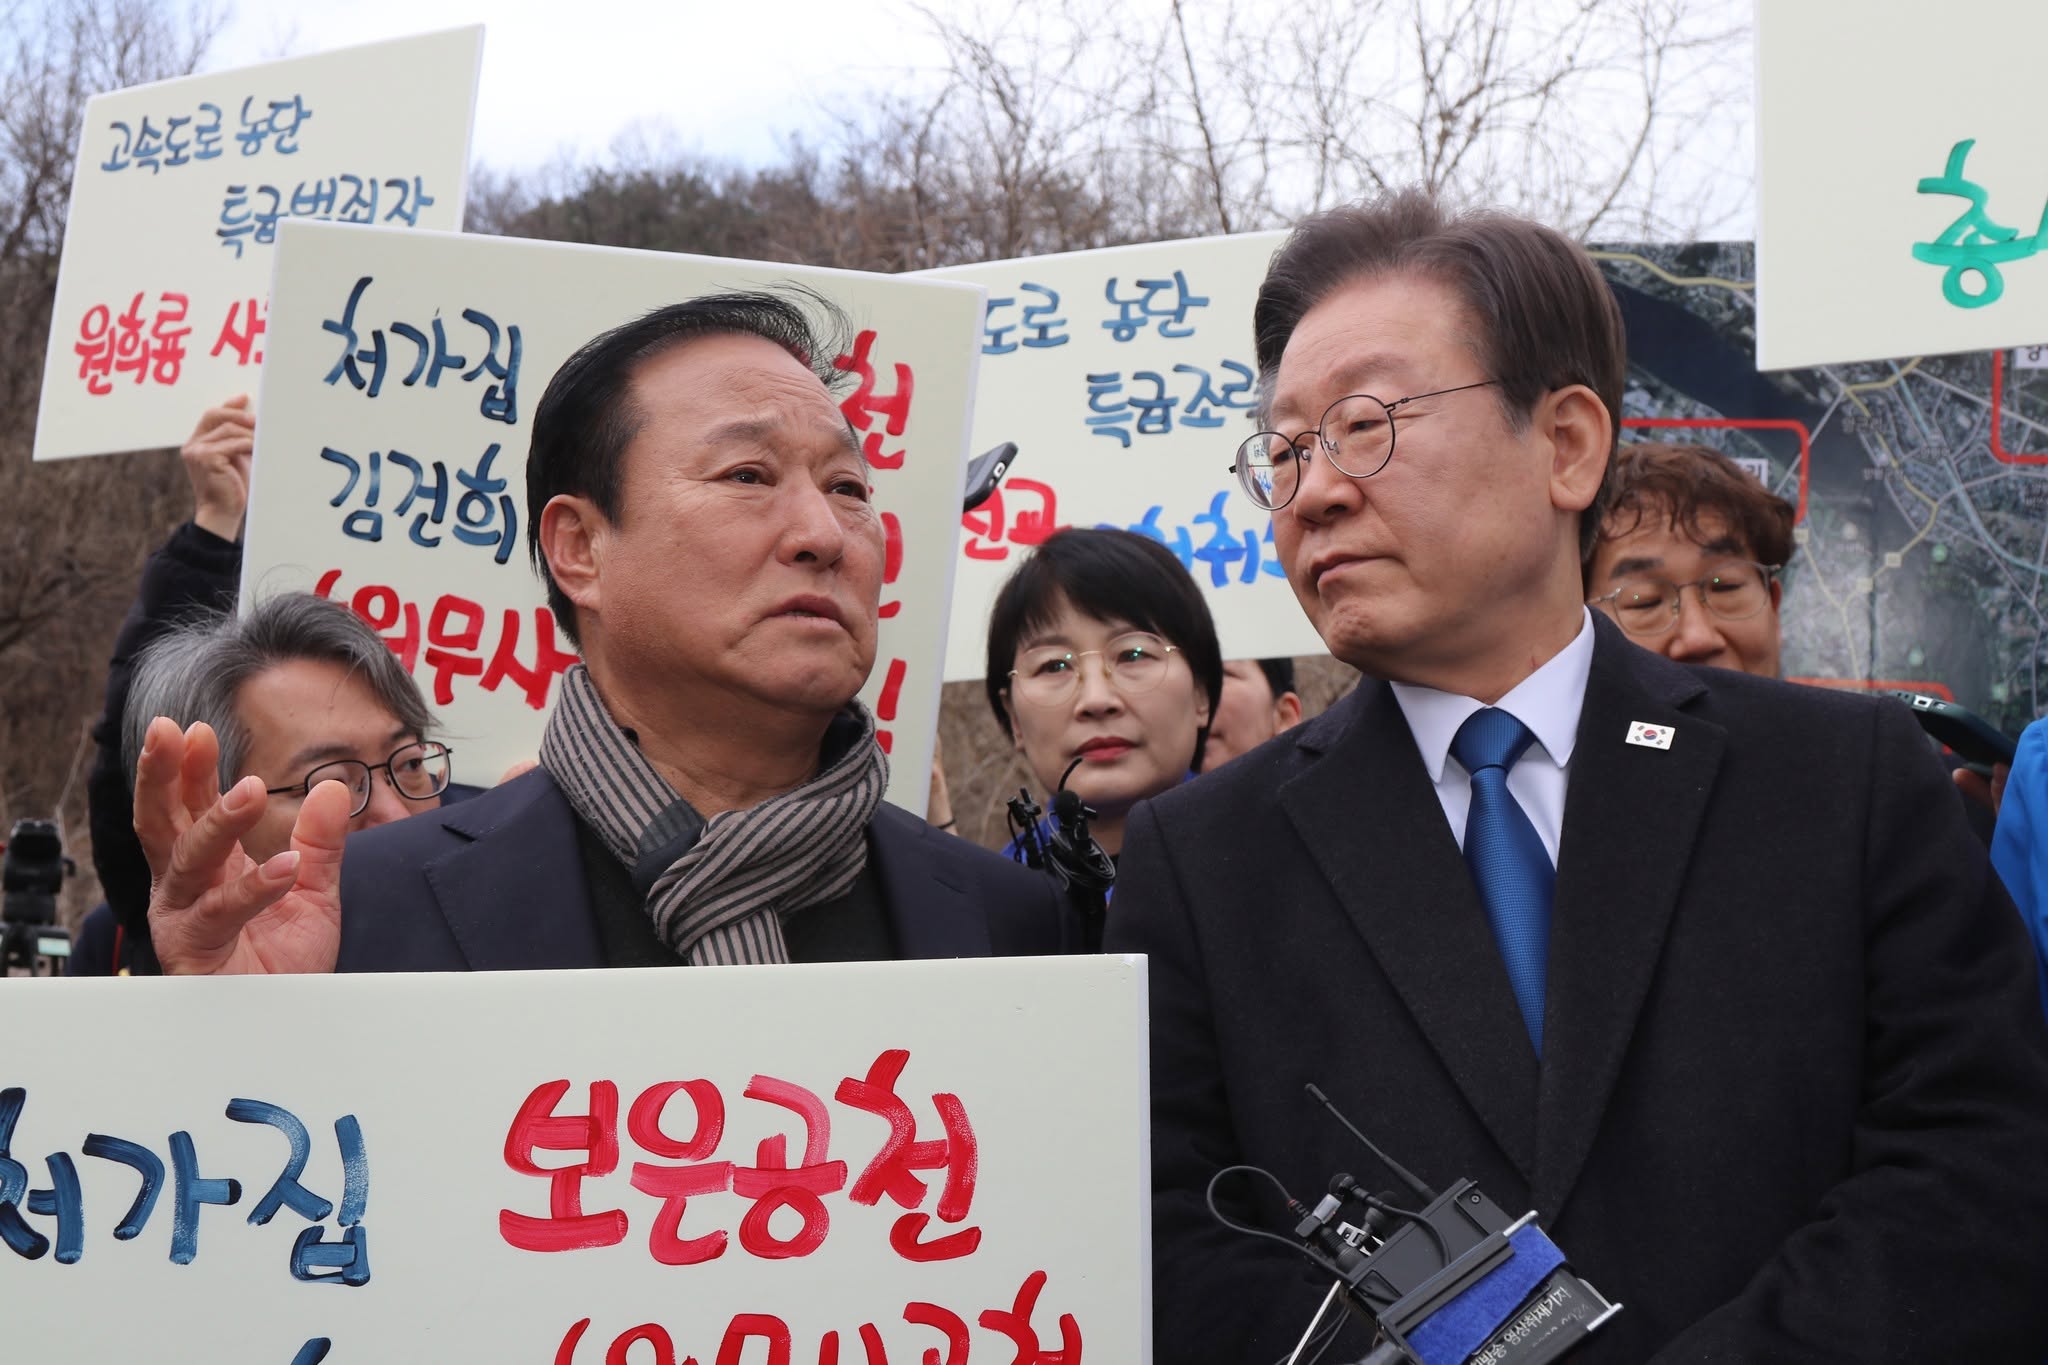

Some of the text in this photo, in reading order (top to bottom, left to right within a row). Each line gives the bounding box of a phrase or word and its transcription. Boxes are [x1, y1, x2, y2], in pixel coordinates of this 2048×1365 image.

[101, 95, 312, 174] 고속도로 농단
[216, 173, 435, 259] 특급범죄자
[1911, 138, 2048, 309] 총
[74, 291, 269, 395] 원희룡 사
[321, 275, 523, 425] 처가집
[1101, 270, 1209, 342] 농단
[320, 443, 518, 565] 김건희
[499, 1048, 982, 1265] 보은공천
